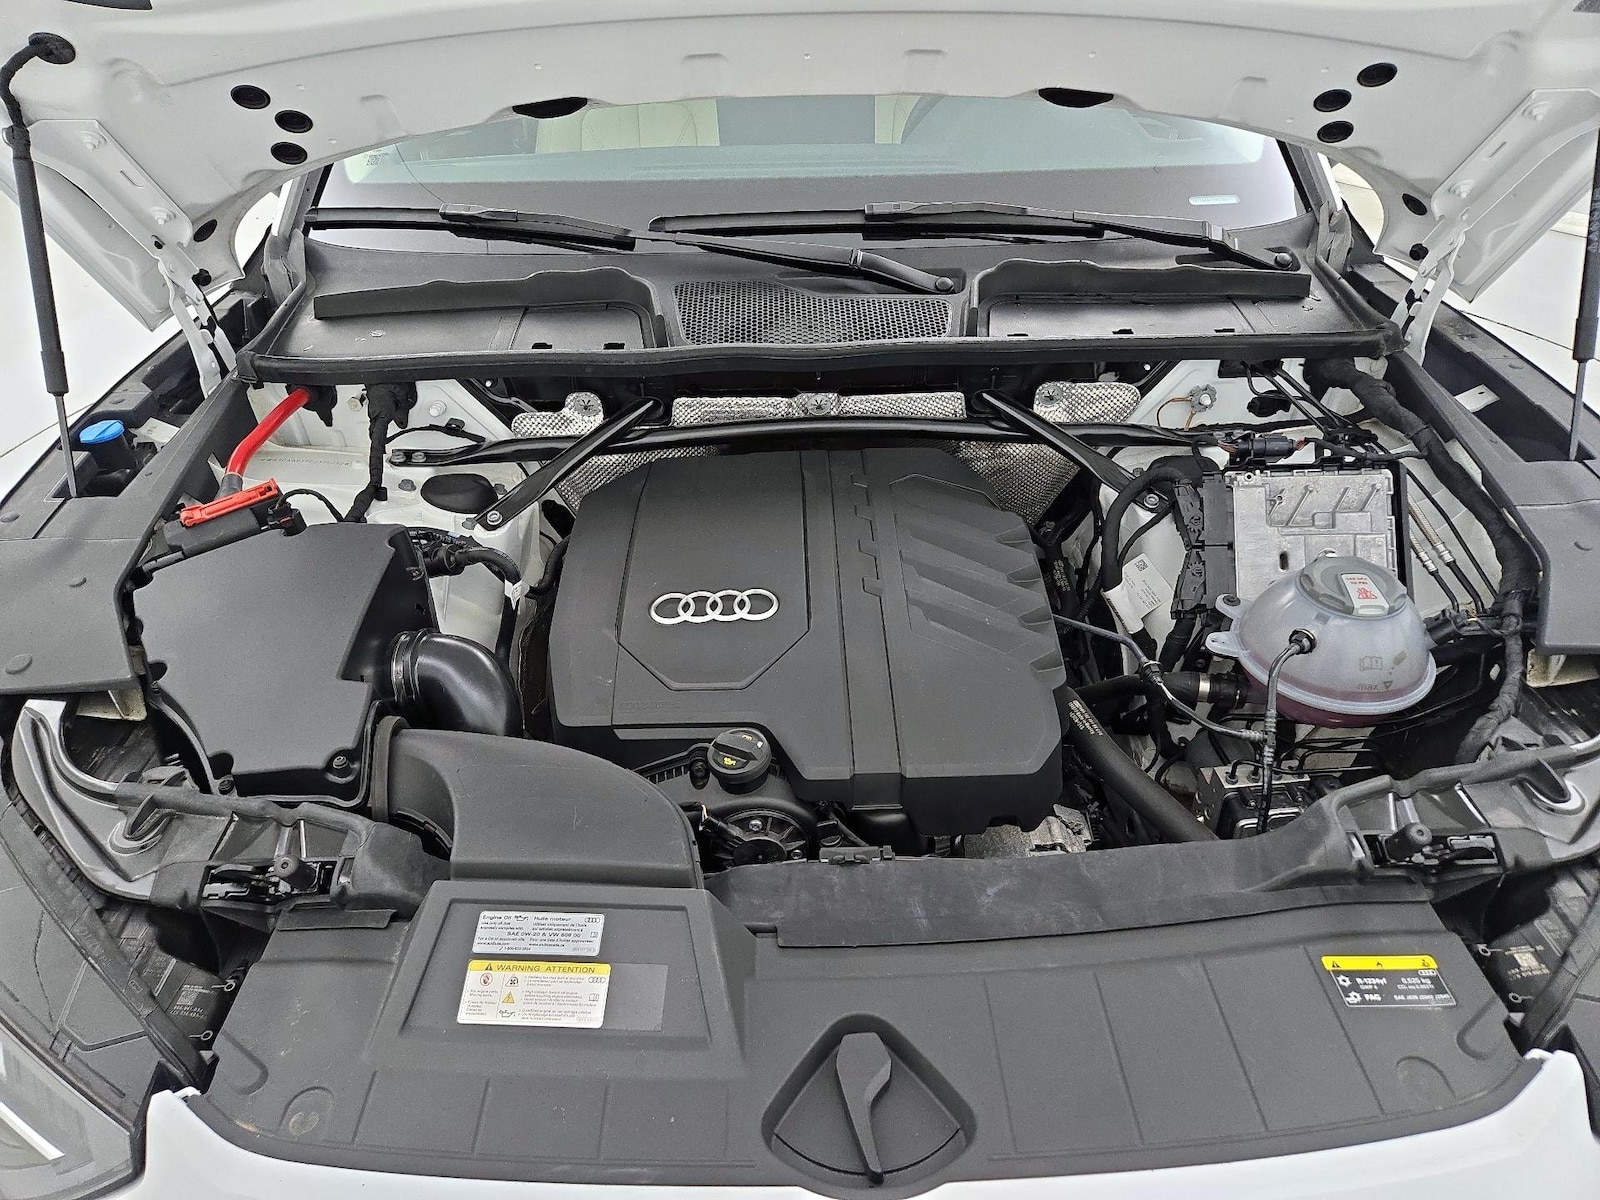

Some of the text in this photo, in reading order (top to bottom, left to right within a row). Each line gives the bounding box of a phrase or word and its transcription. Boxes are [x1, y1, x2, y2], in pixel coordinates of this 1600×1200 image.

[1357, 683, 1378, 691] max
[496, 964, 596, 974] WARNING ATTENTION
[1363, 993, 1382, 1002] PAG
